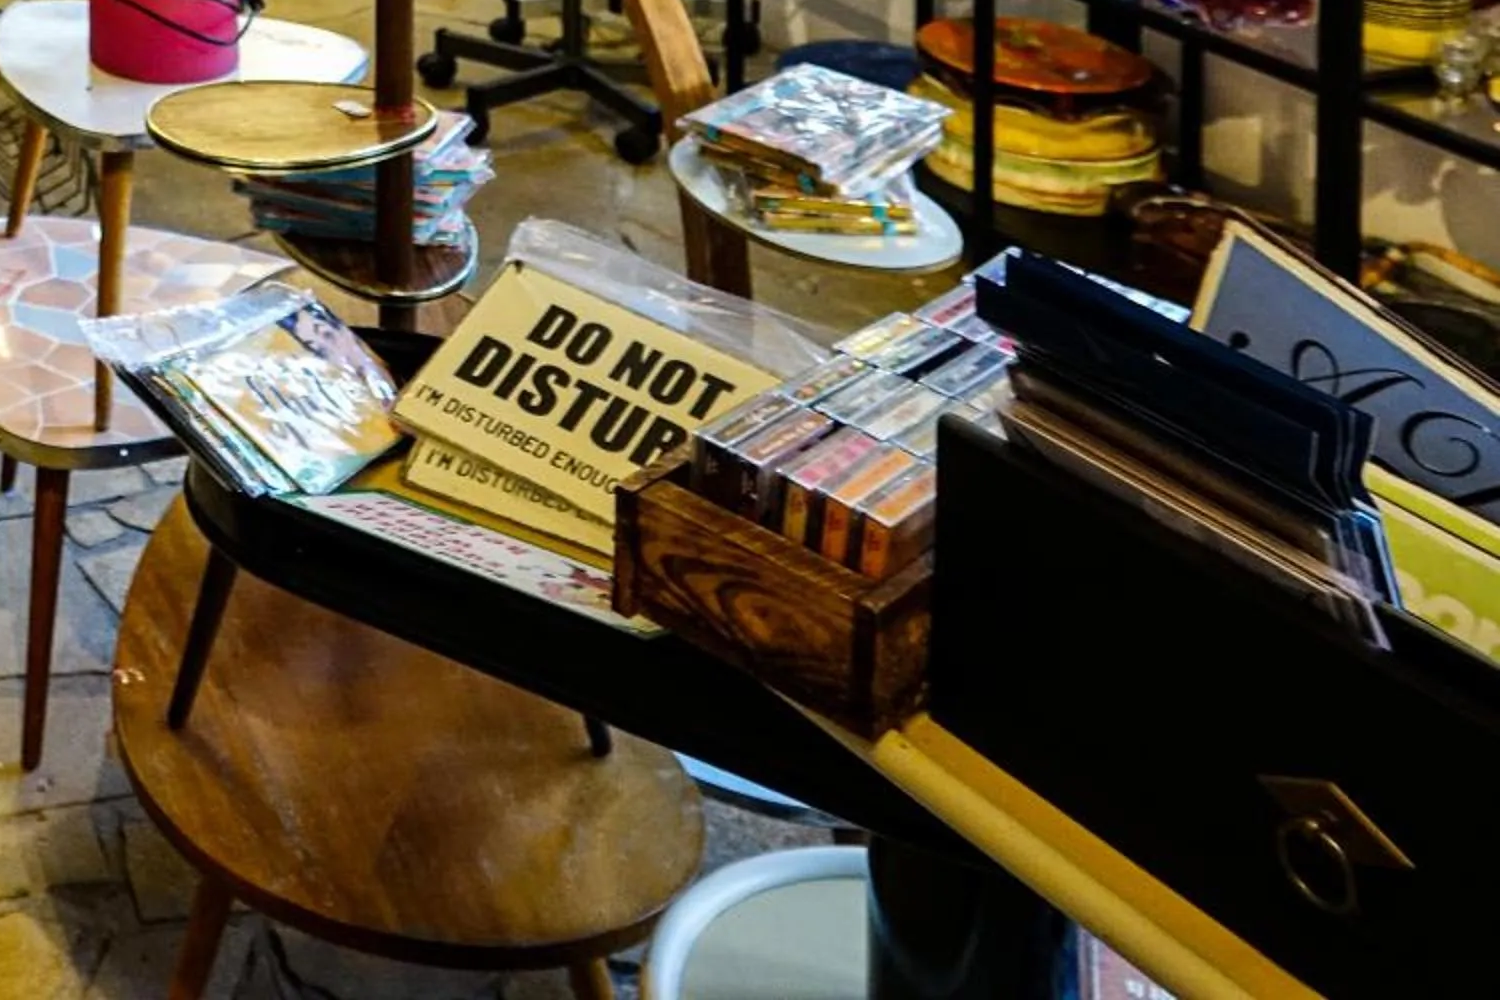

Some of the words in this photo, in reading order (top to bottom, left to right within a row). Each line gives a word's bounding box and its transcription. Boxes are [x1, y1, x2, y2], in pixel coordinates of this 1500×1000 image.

[453, 334, 688, 468] DISTUR
[526, 303, 613, 366] DO
[608, 340, 737, 421] NOT
[415, 384, 445, 407] I'M
[443, 398, 551, 459] DISTURBED
[425, 449, 453, 472] I'M
